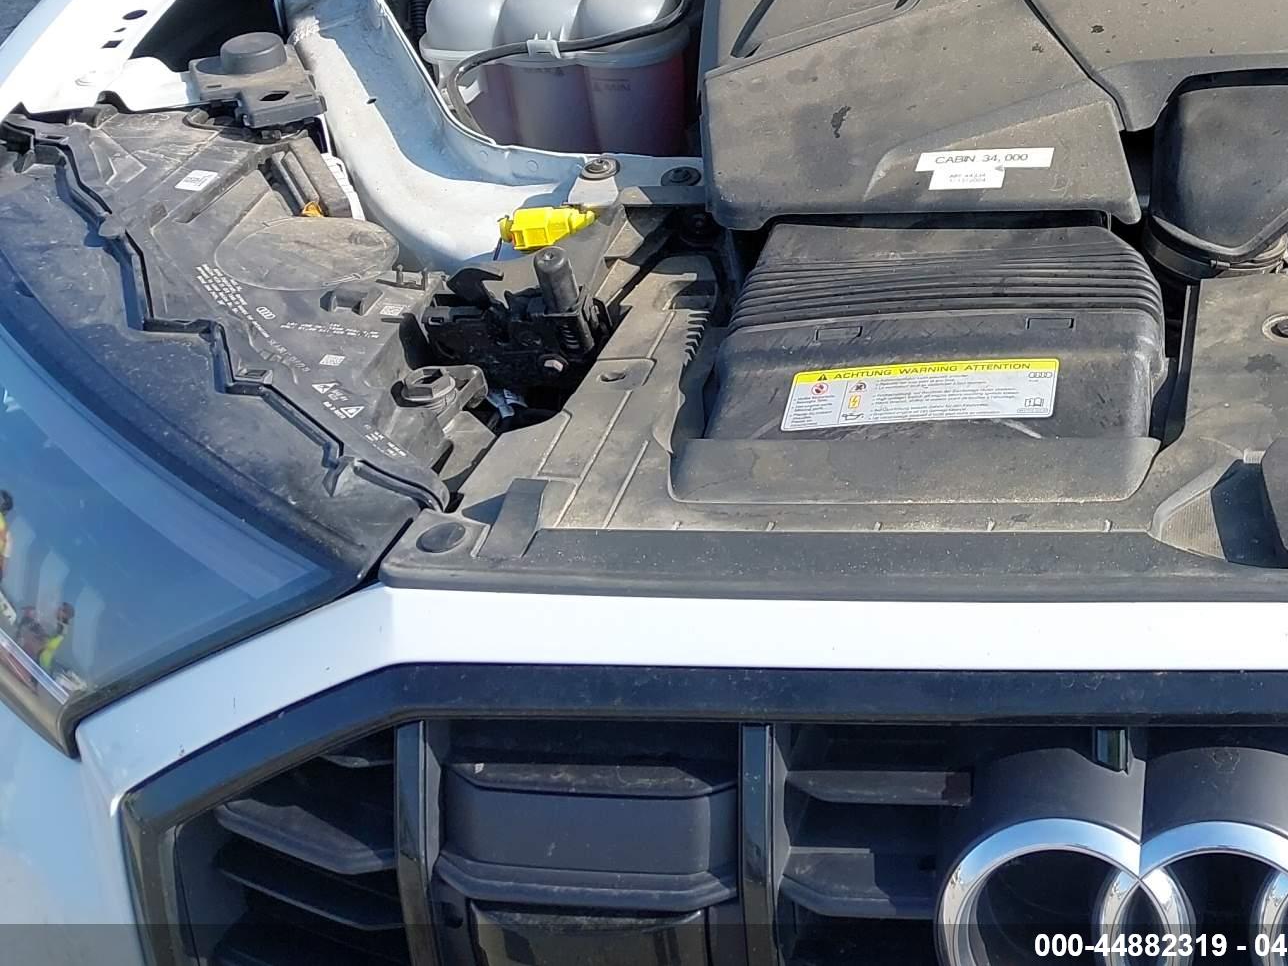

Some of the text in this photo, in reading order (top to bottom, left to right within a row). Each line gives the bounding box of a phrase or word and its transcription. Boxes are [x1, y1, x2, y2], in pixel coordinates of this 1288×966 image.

[935, 155, 976, 164] CABIN
[1004, 153, 1029, 161] 000
[834, 362, 1031, 380] ACHTUNG WARNING ATTENTION
